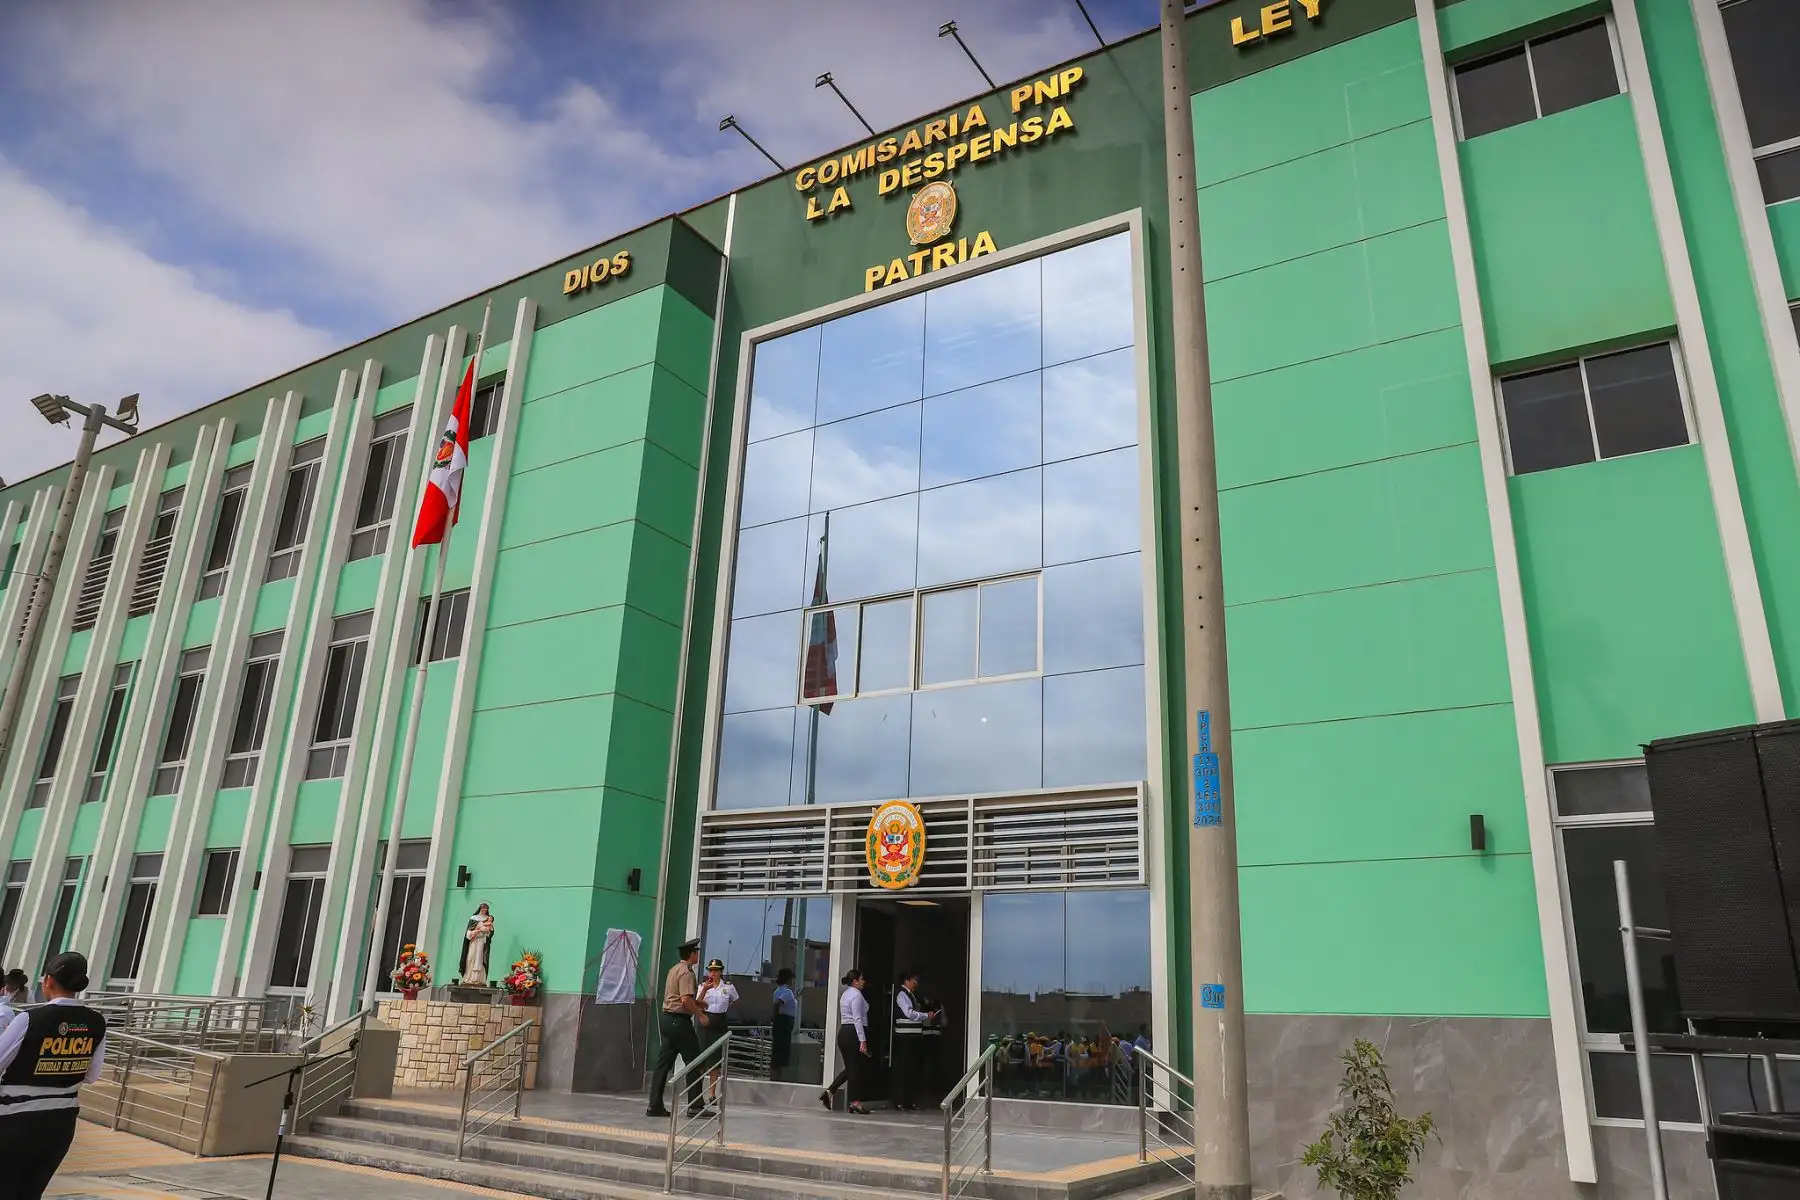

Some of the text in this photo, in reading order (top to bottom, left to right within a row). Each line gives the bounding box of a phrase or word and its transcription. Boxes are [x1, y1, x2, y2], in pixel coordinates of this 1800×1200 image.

[1230, 0, 1320, 46] LEY
[794, 66, 1084, 191] COMISARIA PNP
[806, 105, 1074, 221] LA DESPENSA
[563, 250, 631, 295] DIOS
[865, 230, 998, 292] PATRIA
